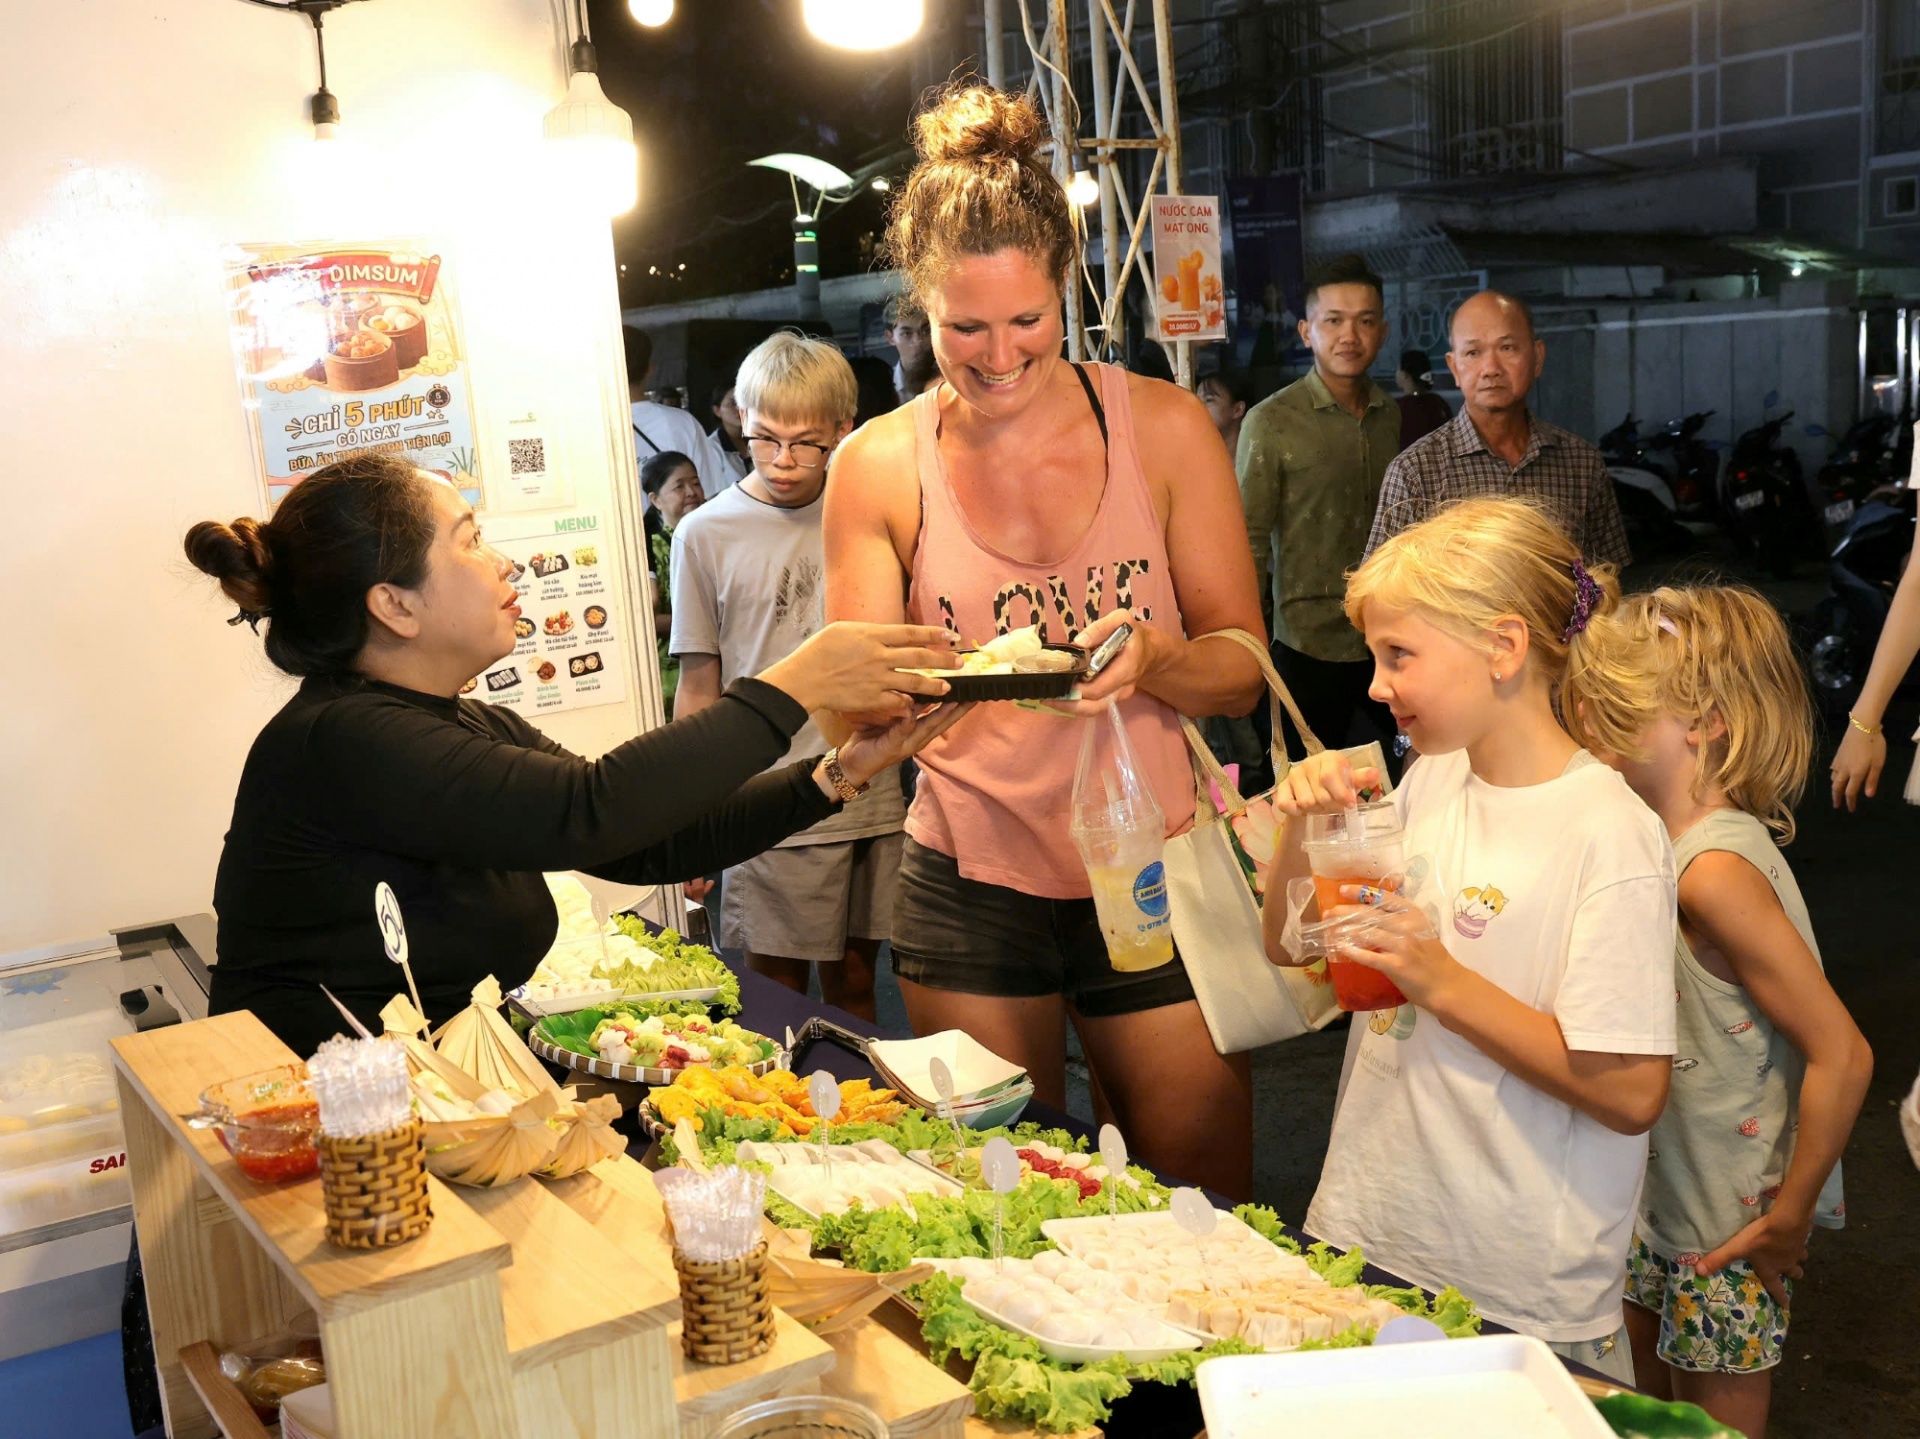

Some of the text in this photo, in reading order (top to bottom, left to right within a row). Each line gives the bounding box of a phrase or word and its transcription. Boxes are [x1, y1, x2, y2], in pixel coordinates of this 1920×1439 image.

[1159, 203, 1212, 217] NƯỚC CAM
[1187, 223, 1209, 233] ONG
[329, 263, 419, 286] DIMSUM
[303, 394, 425, 434] CHỈ 5 PHÚT
[336, 423, 401, 447] CÓ NGAY
[288, 454, 316, 472] BỮA
[316, 451, 334, 466] ĂN
[404, 435, 431, 452] TIỆN
[432, 432, 452, 447] LỢI
[554, 515, 597, 533] MENU
